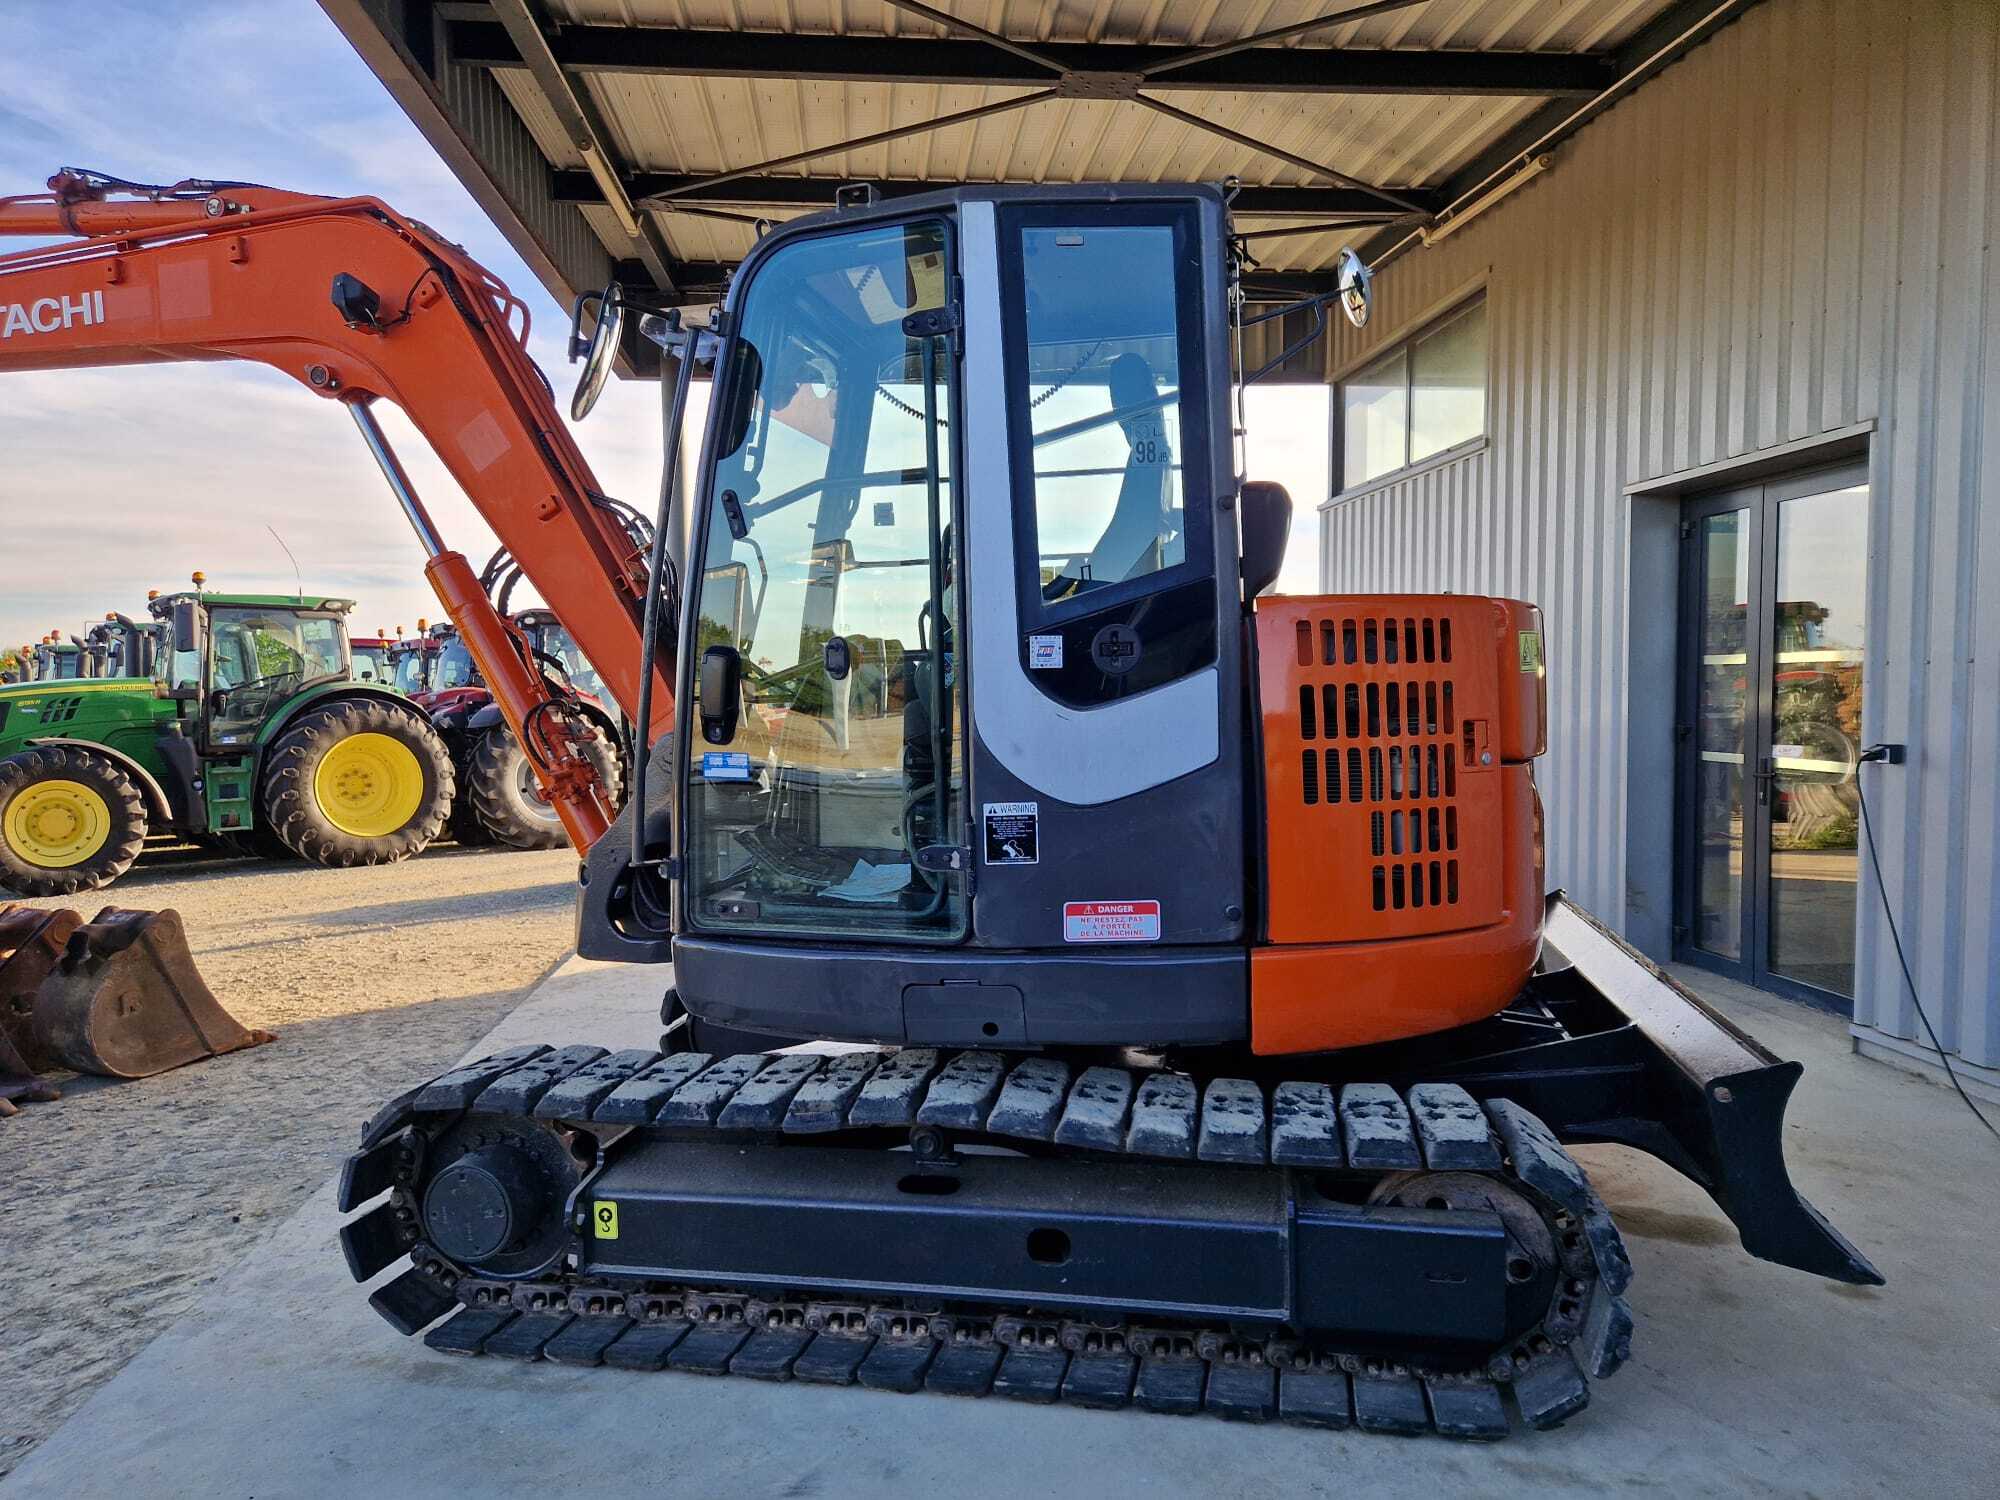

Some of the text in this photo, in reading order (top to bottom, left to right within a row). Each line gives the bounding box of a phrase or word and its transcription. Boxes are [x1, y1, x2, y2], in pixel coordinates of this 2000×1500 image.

[1135, 441, 1156, 463] 98
[1000, 804, 1036, 813] WARNING
[1098, 905, 1135, 913] DANGER
[1107, 929, 1144, 937] MACHINE
